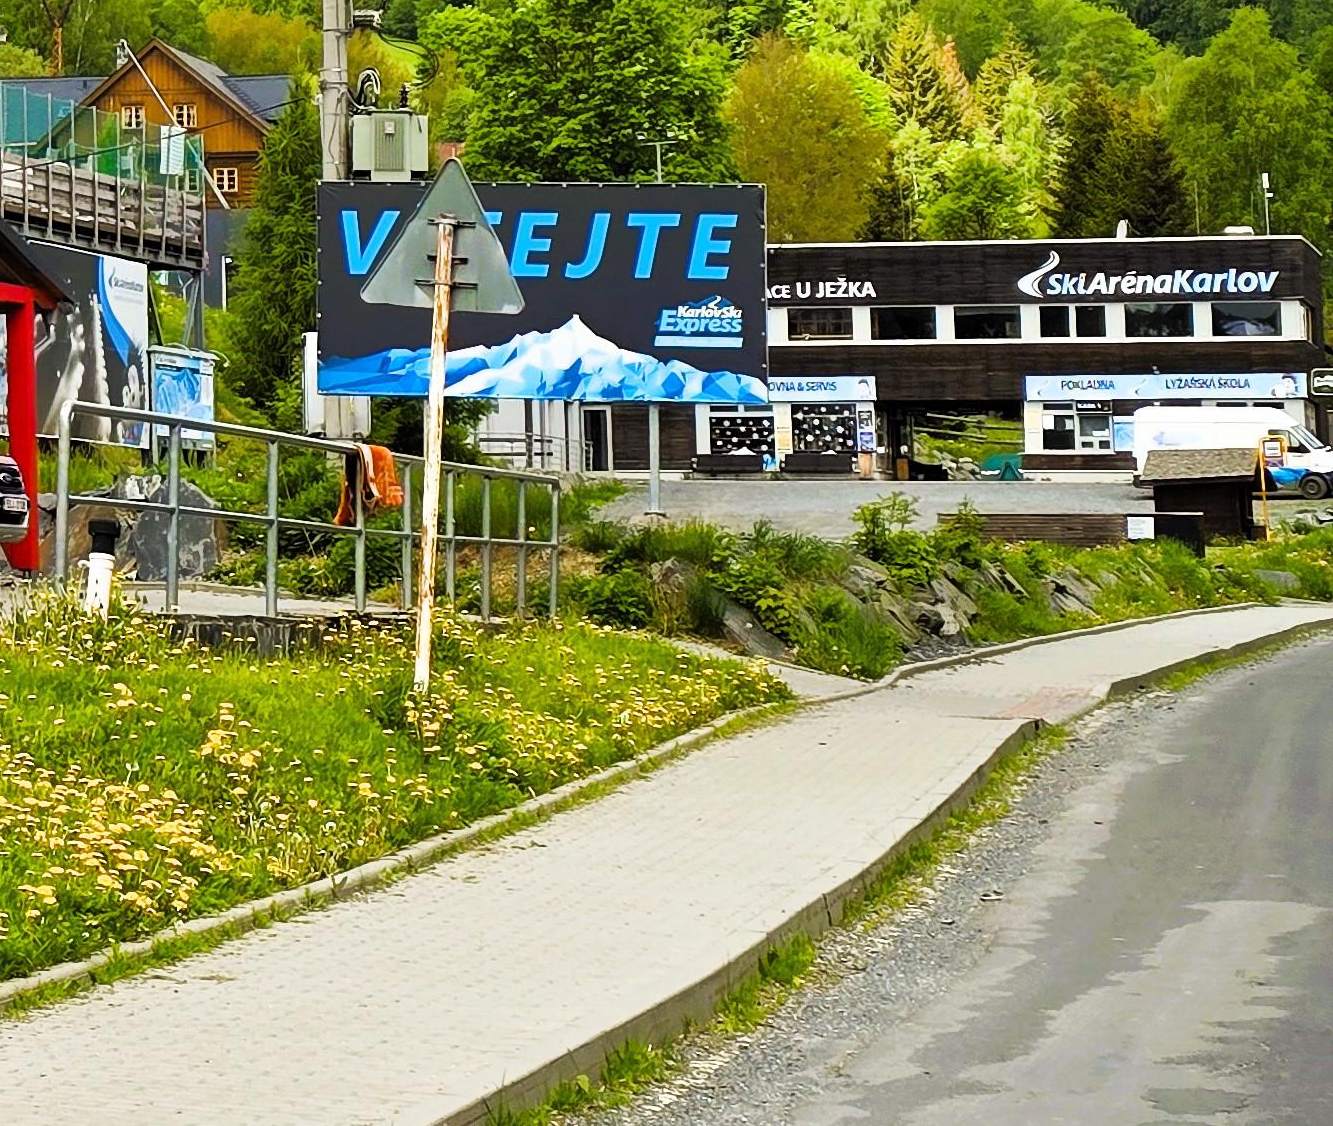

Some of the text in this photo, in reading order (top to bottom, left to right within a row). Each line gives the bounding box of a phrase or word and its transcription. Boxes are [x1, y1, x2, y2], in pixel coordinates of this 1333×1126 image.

[340, 210, 739, 280] VEJTE
[795, 281, 811, 299] U
[815, 276, 877, 298] JEŽKA
[659, 309, 743, 334] Express
[805, 381, 838, 392] SERVIS
